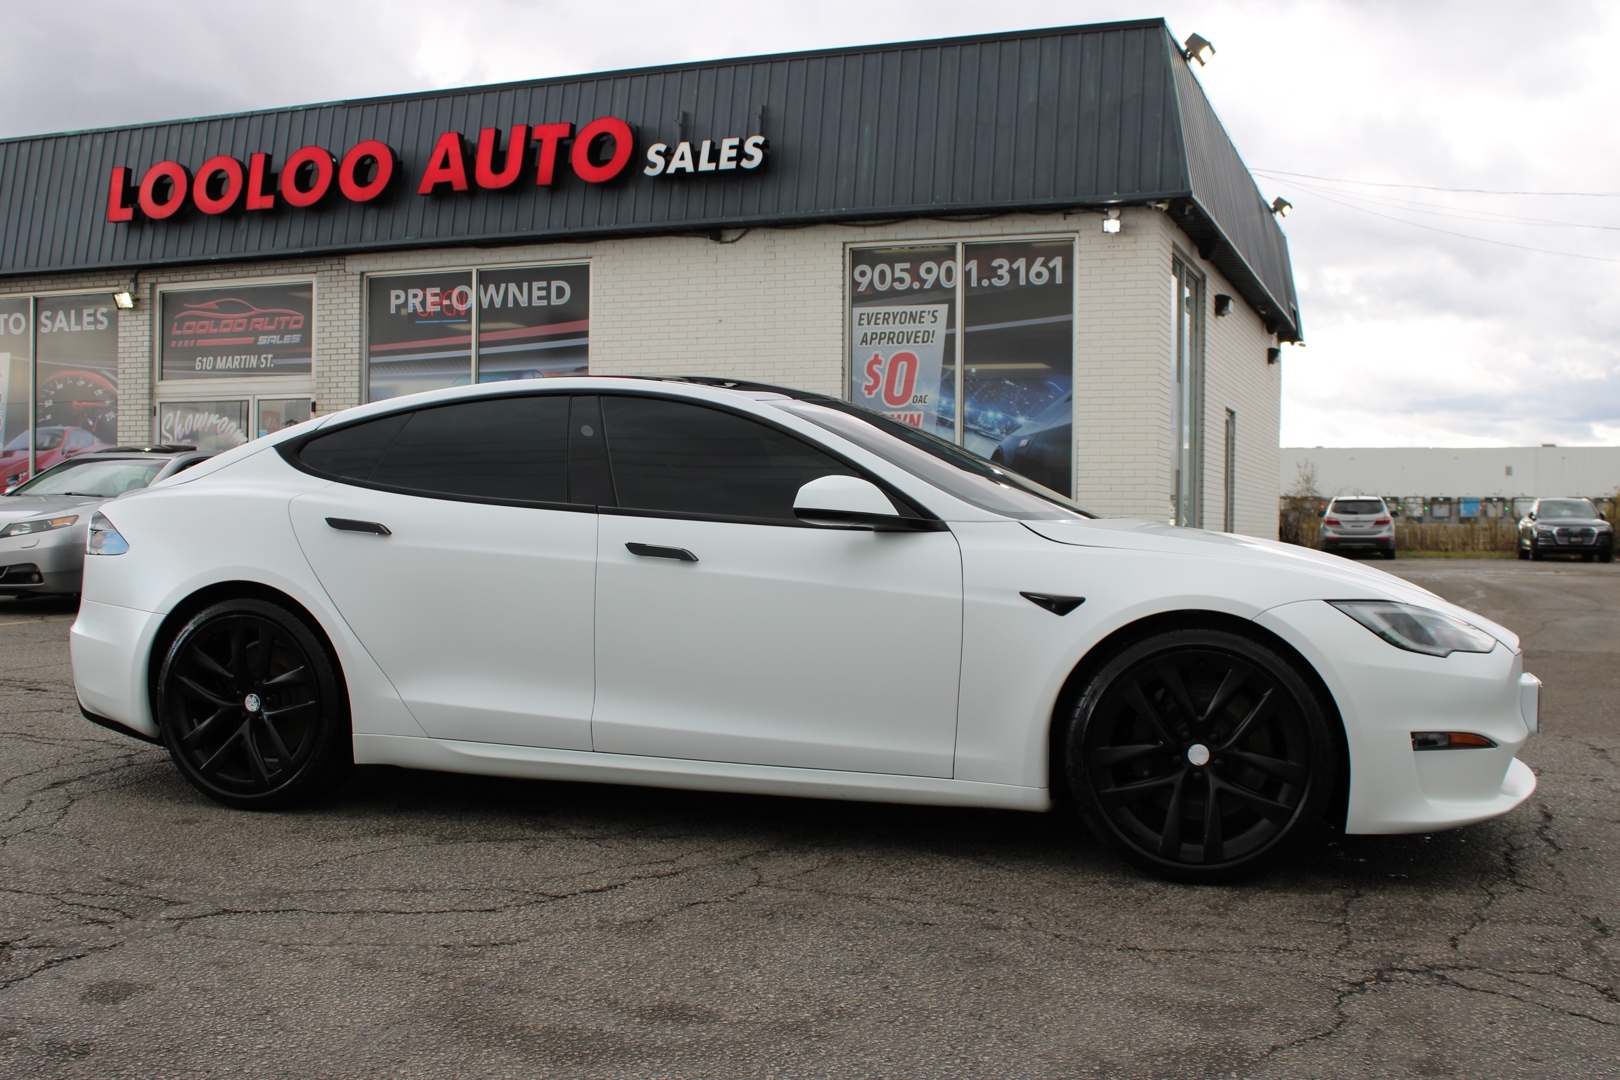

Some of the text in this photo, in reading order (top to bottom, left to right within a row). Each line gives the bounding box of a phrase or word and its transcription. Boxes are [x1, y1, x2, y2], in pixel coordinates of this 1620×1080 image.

[107, 116, 766, 223] LOOLOO AUTO SALES
[853, 256, 1063, 292] 905.901.3161
[390, 280, 572, 314] PRE-OWNED
[40, 307, 109, 333] SALES
[171, 315, 305, 335] LOOLOO AUTO
[857, 309, 939, 327] EVERYONE'S
[257, 334, 302, 345] SALES
[859, 329, 936, 346] APPROVED!
[195, 354, 275, 371] 610 MARTIN ST.
[863, 351, 918, 406] $0
[912, 394, 929, 405] OAC
